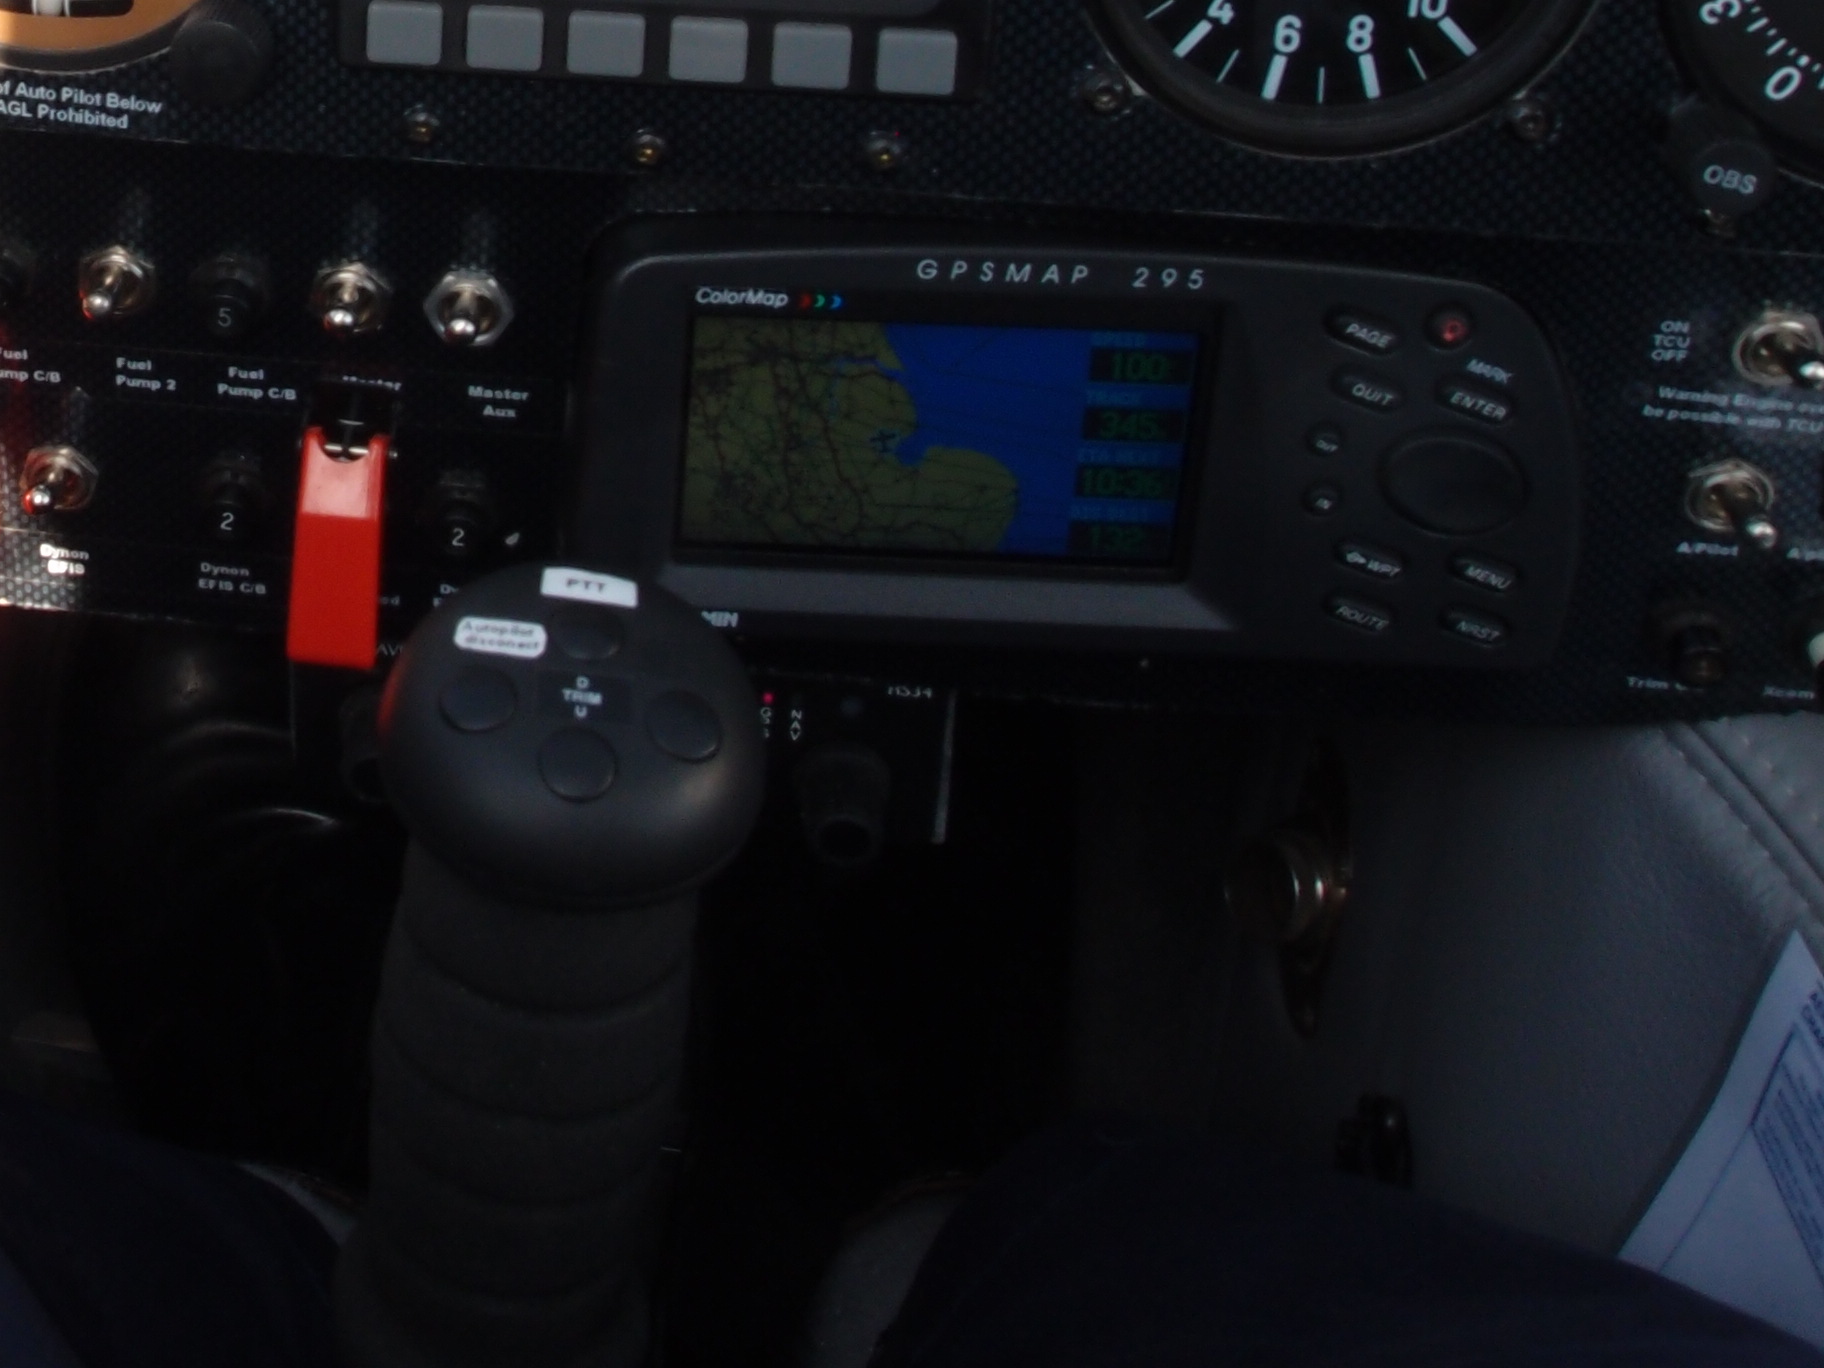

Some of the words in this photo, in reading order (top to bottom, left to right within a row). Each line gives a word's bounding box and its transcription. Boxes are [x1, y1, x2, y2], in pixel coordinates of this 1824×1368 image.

[1273, 13, 1303, 55] 6
[1345, 13, 1376, 55] 8
[15, 81, 57, 102] Auto
[61, 86, 102, 107] Pilot
[106, 91, 163, 114] Below
[37, 103, 130, 129] Prohibited
[1702, 163, 1759, 196] OBS
[916, 258, 1091, 287] GPSMAP
[1131, 266, 1206, 291] 295
[694, 286, 790, 311] ColorMap
[216, 307, 233, 328] 5
[1660, 319, 1691, 334] ON
[1345, 322, 1397, 349] PAGE
[1653, 333, 1692, 348] TCU
[115, 357, 153, 372] Fuel
[1650, 348, 1689, 363] OFF
[227, 365, 265, 382] Fuel
[1112, 351, 1169, 381] 100
[33, 369, 61, 384] C/B
[115, 374, 162, 392] Pump
[165, 378, 177, 392] 2
[216, 382, 264, 401] Pump
[267, 386, 297, 402] C/B
[467, 384, 530, 402] Master
[1351, 382, 1395, 406] QUIT
[1657, 385, 1730, 408] Warning
[482, 403, 518, 419] Aux
[1449, 390, 1507, 420] ENTER
[1641, 403, 1665, 418] be
[219, 511, 235, 531] 2
[451, 527, 466, 547] 2
[39, 542, 90, 561] Dynon
[199, 561, 251, 578] Dynon
[1463, 564, 1512, 590] MENU
[197, 578, 235, 594] EFIS
[238, 581, 268, 596] C/B
[566, 578, 606, 594] PTT
[561, 687, 604, 707] TRIM
